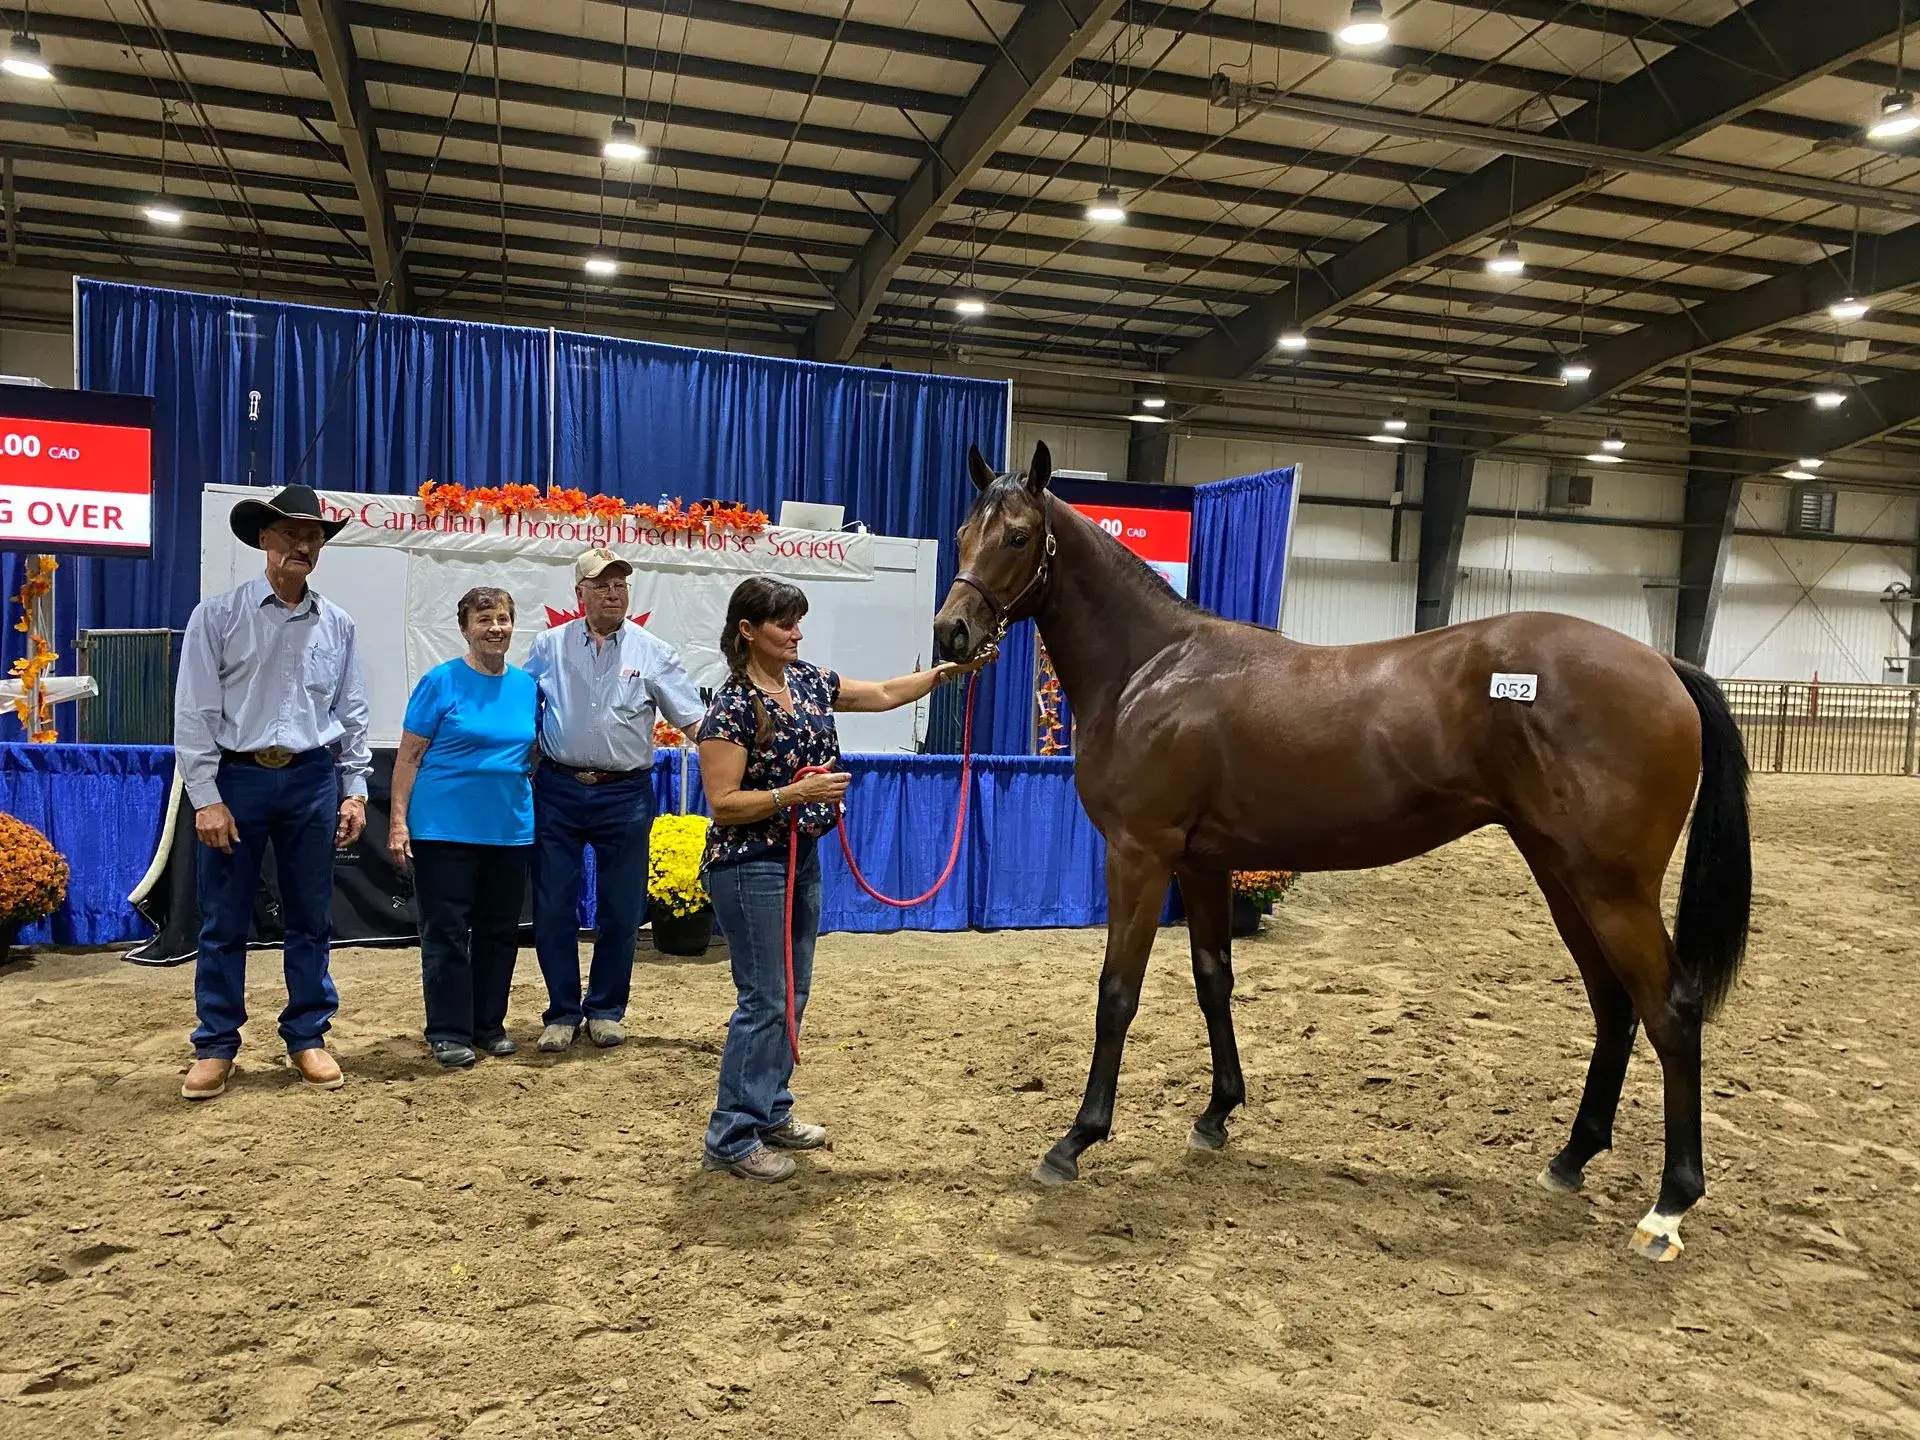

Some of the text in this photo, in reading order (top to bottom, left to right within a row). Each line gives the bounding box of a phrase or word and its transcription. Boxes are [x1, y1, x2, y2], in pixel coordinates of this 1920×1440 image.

[48, 447, 80, 460] CAD
[27, 501, 124, 530] OVER
[320, 498, 851, 568] he Canadian Thoroughbred Horse Society
[1126, 527, 1147, 538] CAD
[1496, 682, 1531, 698] 052
